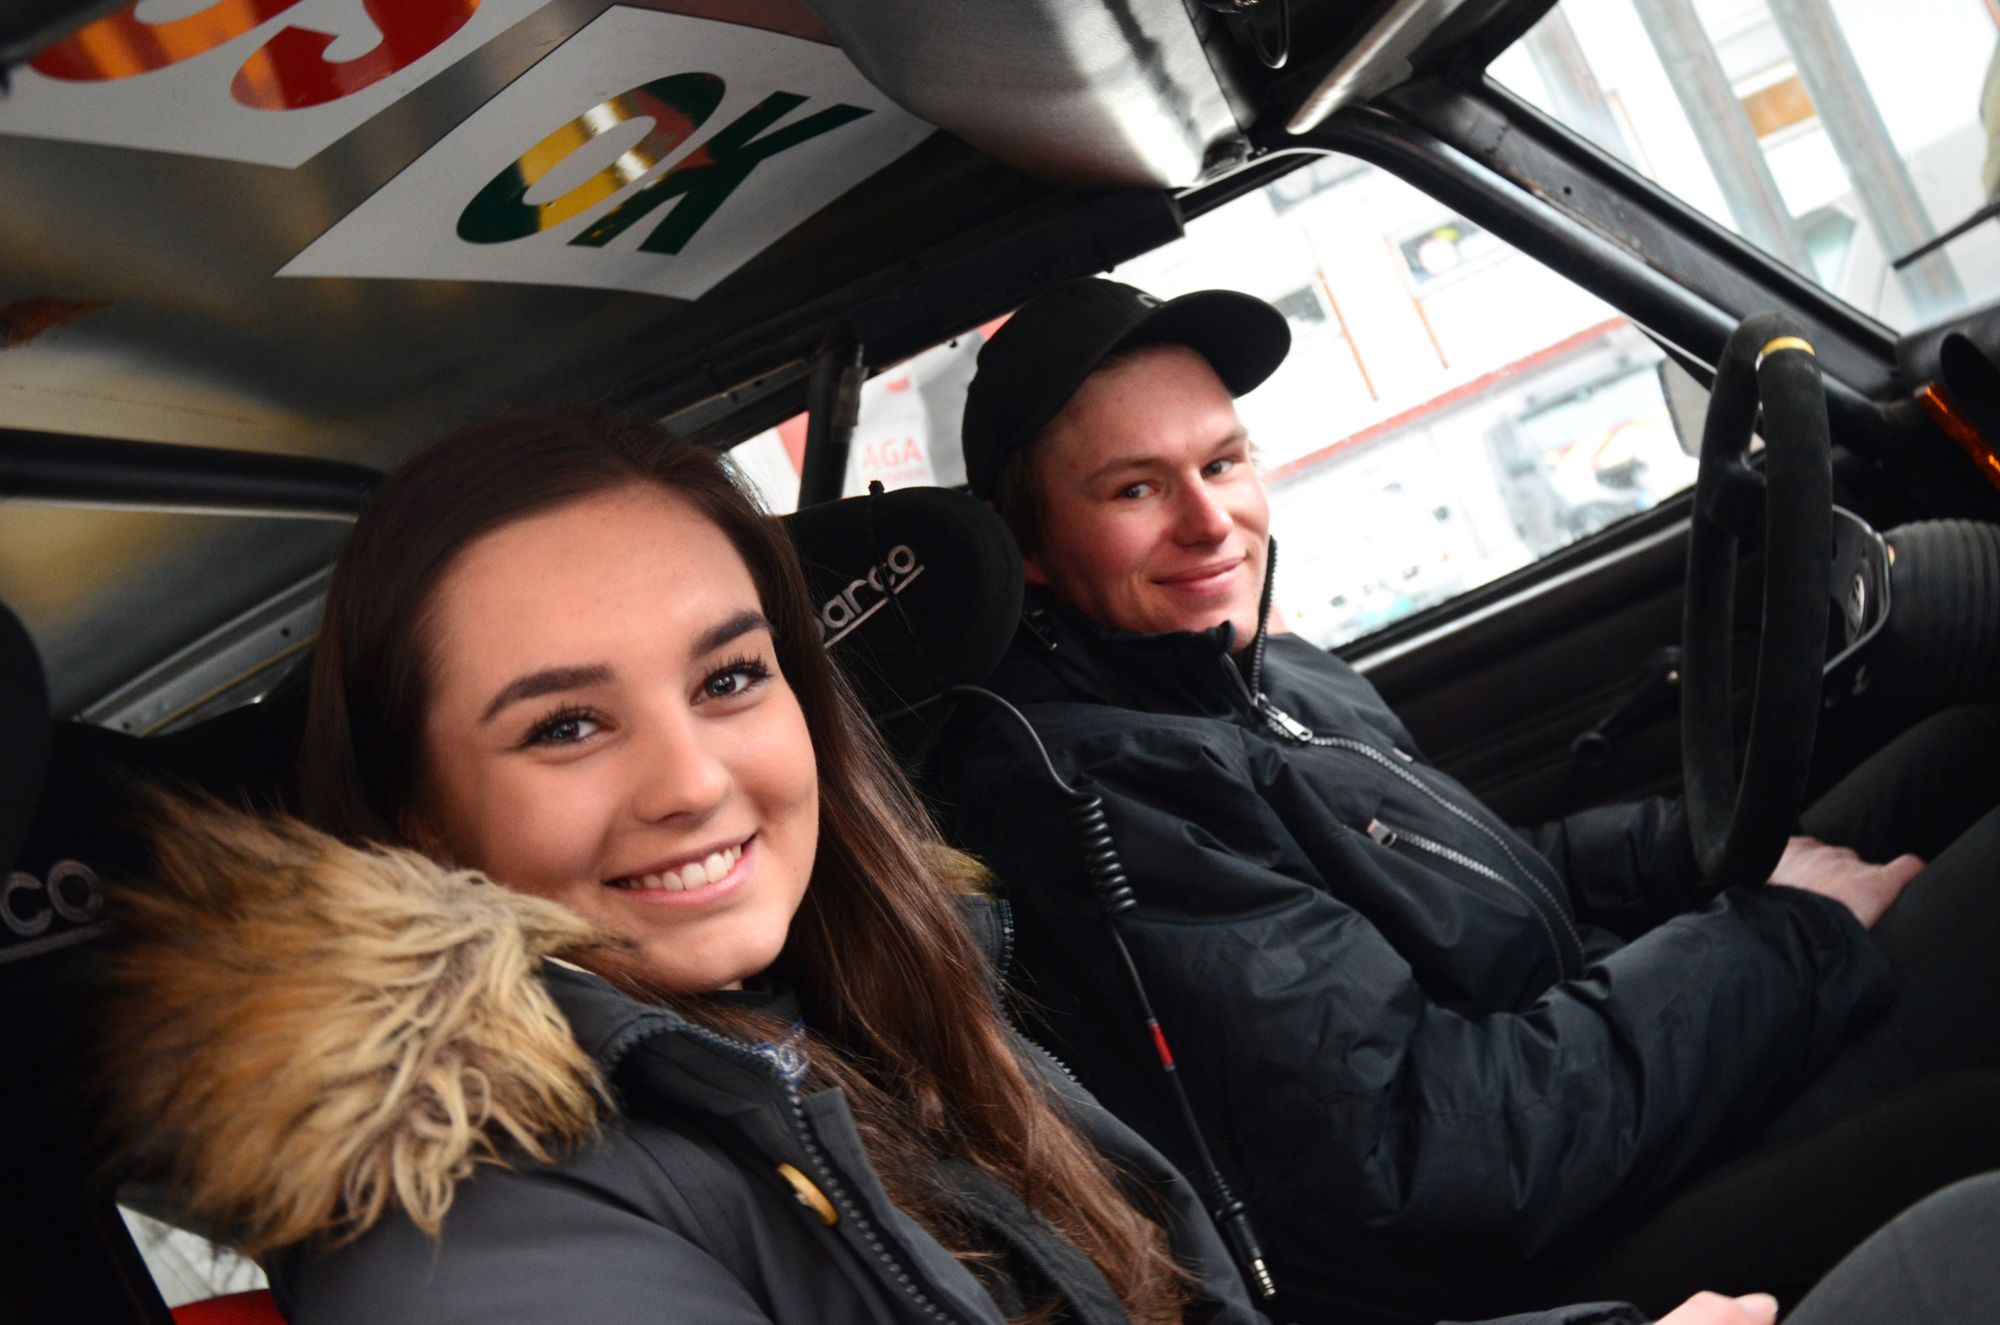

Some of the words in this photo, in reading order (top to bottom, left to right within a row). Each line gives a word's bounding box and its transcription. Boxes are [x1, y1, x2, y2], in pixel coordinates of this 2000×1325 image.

[456, 72, 875, 255] OK
[862, 436, 924, 470] AGA
[815, 545, 916, 640] arco
